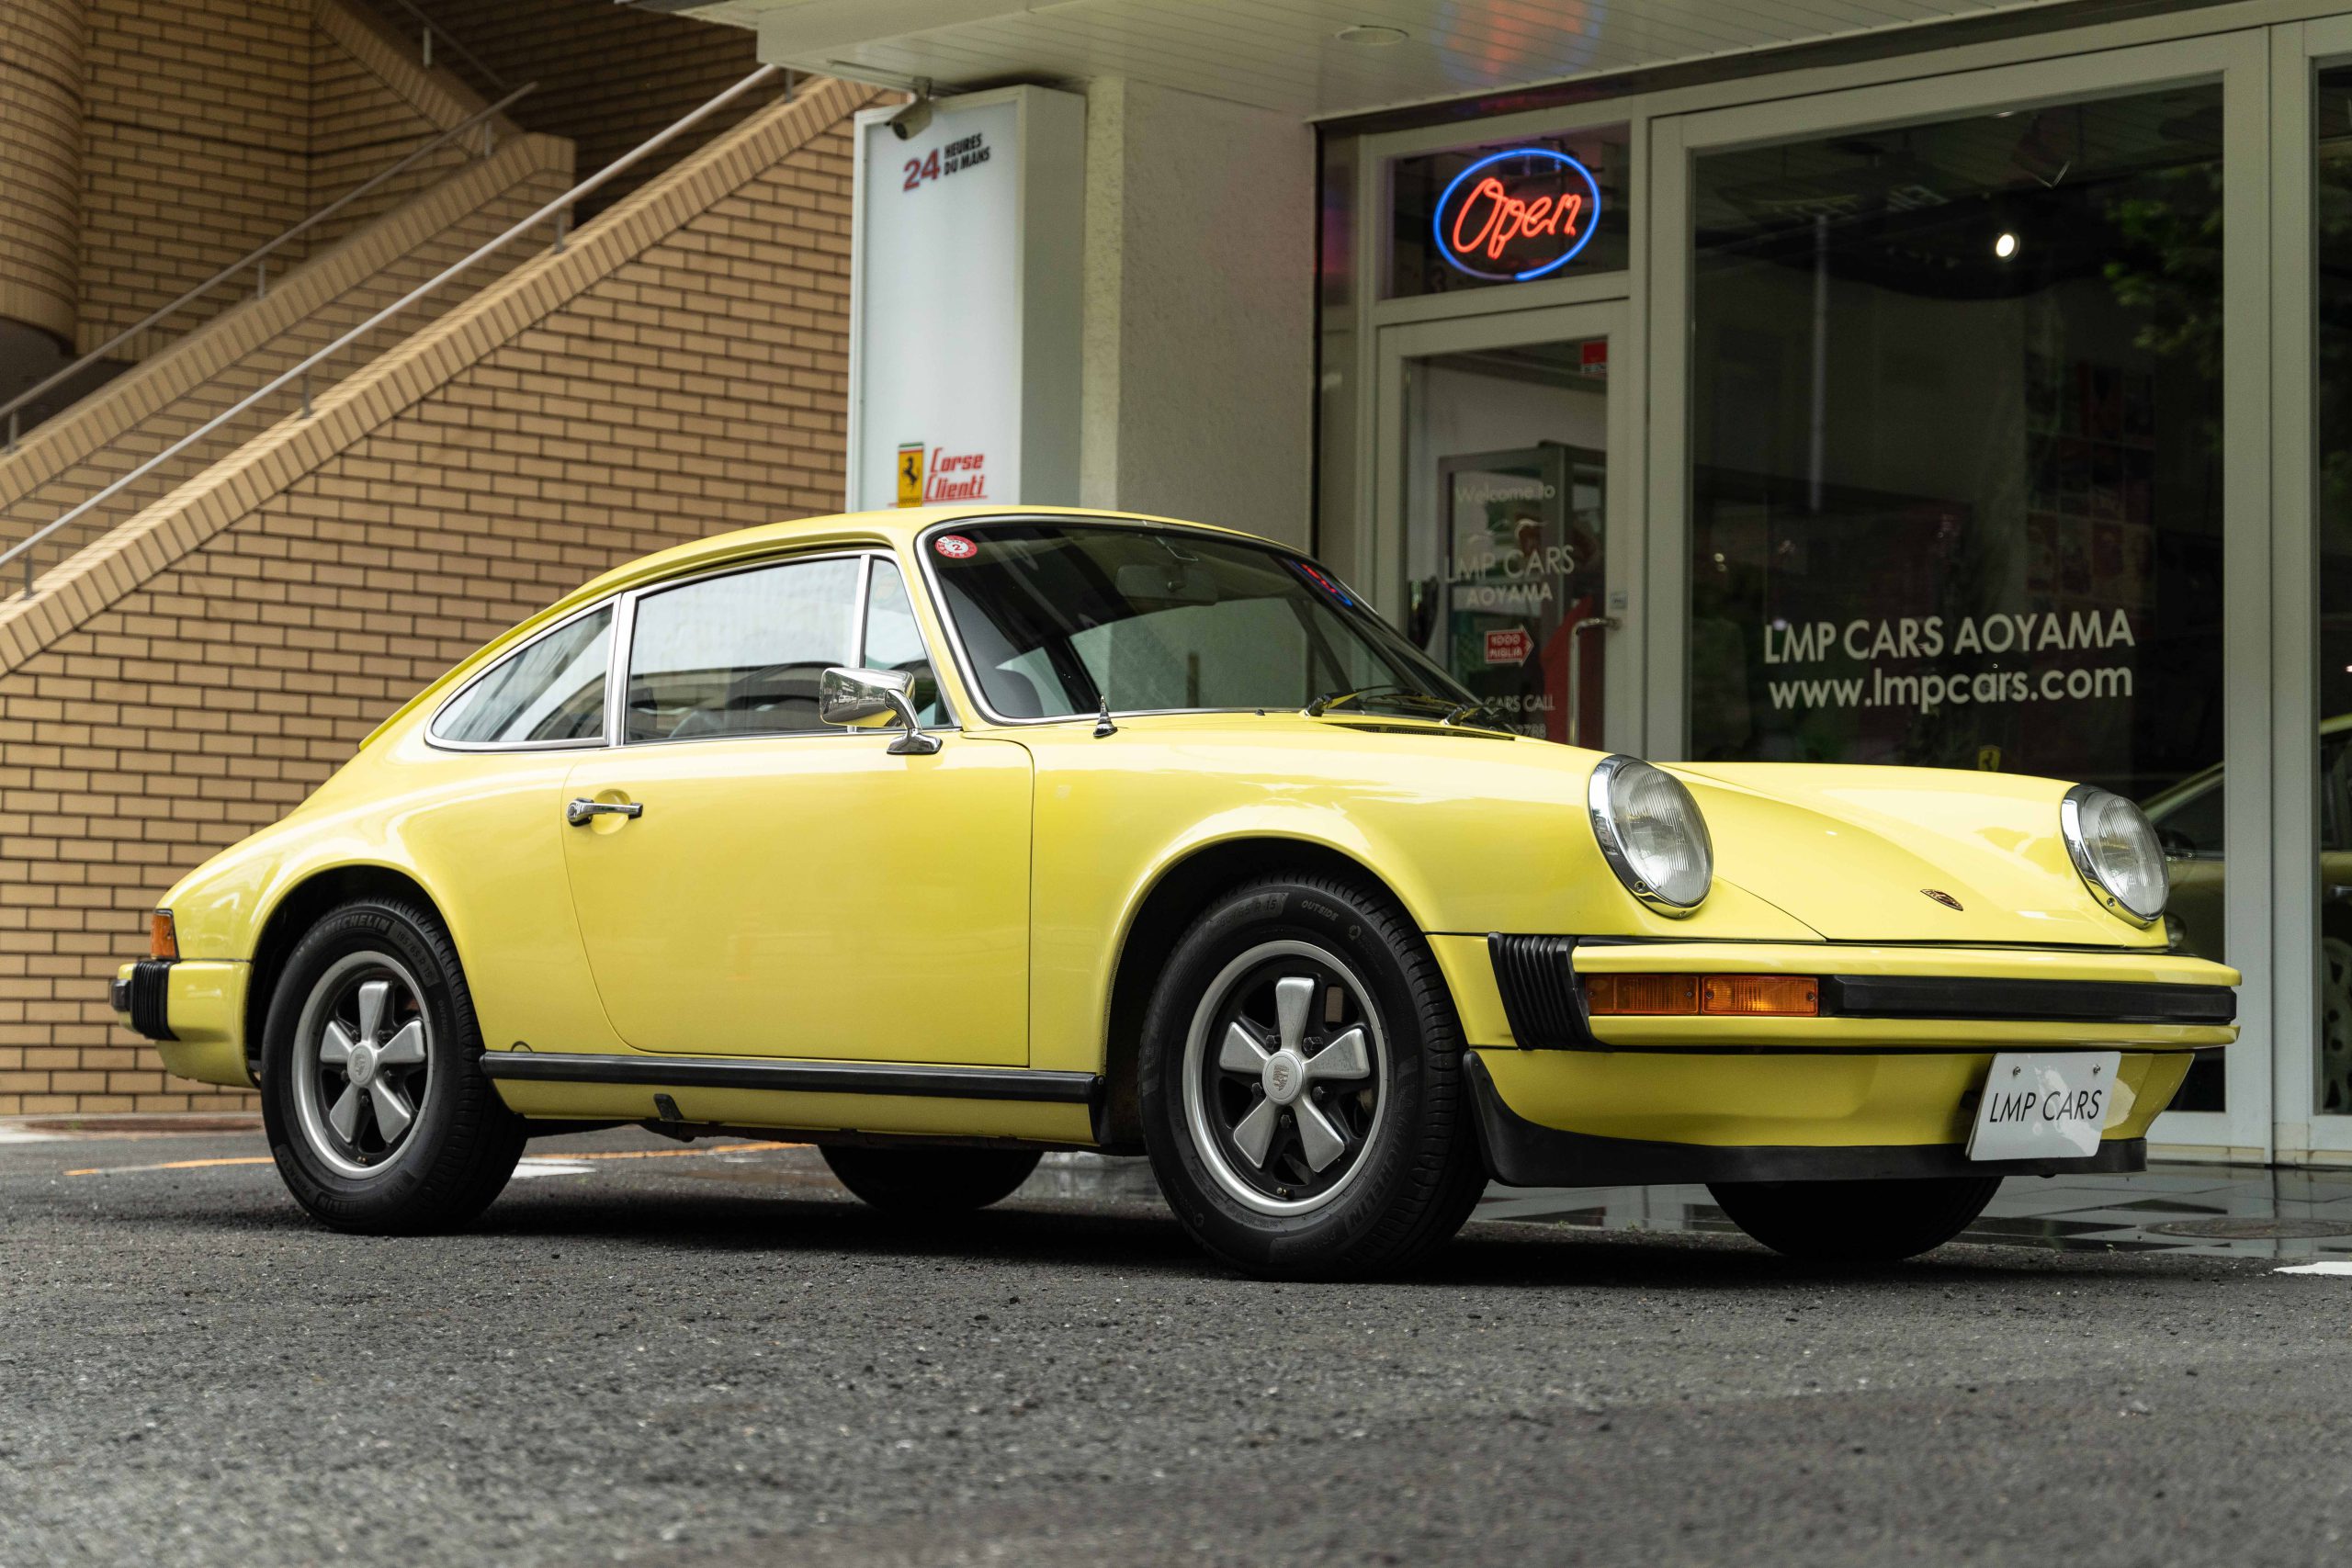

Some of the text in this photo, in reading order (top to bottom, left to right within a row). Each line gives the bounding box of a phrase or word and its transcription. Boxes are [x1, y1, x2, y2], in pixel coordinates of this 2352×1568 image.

[944, 132, 982, 159] HEURES
[903, 147, 941, 192] 24
[944, 146, 990, 175] DU MANS
[1453, 177, 1582, 259] Open
[931, 446, 985, 473] Corse
[924, 473, 985, 500] Clienti
[1455, 483, 1556, 504] Welcome to
[1444, 545, 1575, 583] LMP CARS
[1466, 581, 1553, 607] AOYAMA
[1491, 635, 1521, 647] 1000
[1765, 608, 2135, 664] LMP CARS AOYAMA
[1523, 694, 1555, 712] CALL
[1770, 666, 2133, 714] www.lmpcars.com
[1301, 899, 1340, 921] OUTSIDE
[325, 915, 390, 933] MICHELIN
[397, 931, 420, 957] 195/65
[1989, 1089, 2103, 1123] LMP CARS
